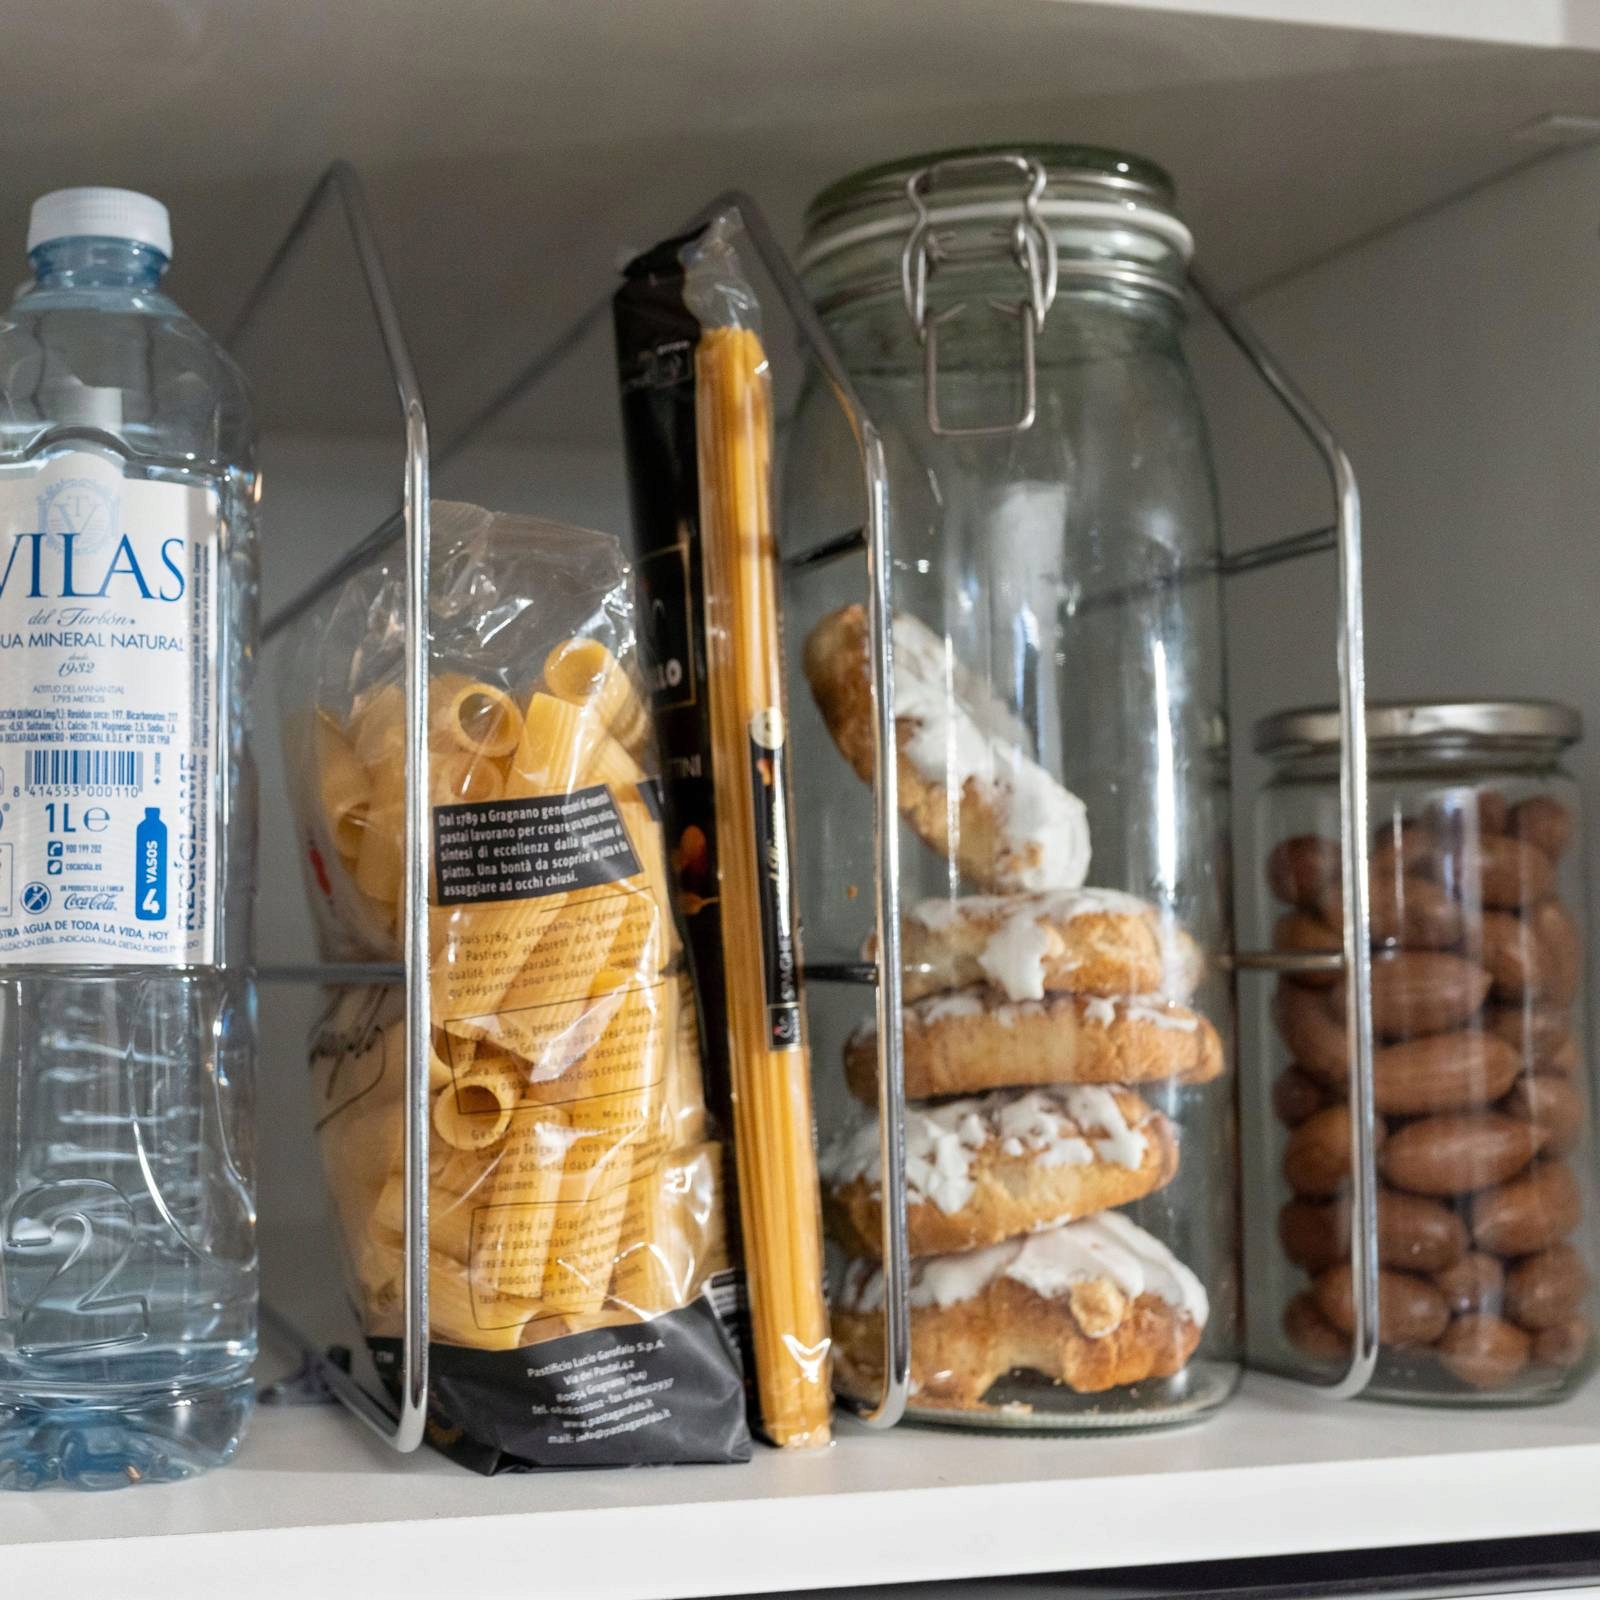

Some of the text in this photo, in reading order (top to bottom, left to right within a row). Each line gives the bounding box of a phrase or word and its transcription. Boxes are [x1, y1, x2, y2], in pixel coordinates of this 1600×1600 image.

[28, 608, 56, 625] del
[0, 632, 185, 652] UA MINERAL NATURAL
[58, 661, 96, 678] 1982
[13, 785, 139, 798] 8 414553 000110
[438, 813, 455, 827] Dal
[456, 811, 479, 827] 1789
[480, 812, 487, 823] a
[488, 807, 540, 824] Gragnano
[440, 830, 469, 845] pastai
[470, 828, 516, 842] lavorano
[518, 826, 535, 840] per
[538, 822, 571, 836] creare
[440, 847, 473, 861] sintesi
[478, 845, 488, 858] di
[493, 842, 549, 857] eccellenza
[554, 836, 579, 851] dalla
[442, 864, 475, 881] piatto.
[477, 864, 498, 876] Una
[501, 858, 532, 874] bontà
[535, 858, 549, 870] da
[552, 851, 590, 869] scoprire
[142, 840, 161, 914] 4 VASOS
[443, 869, 579, 898] assaggiare ad occhi chiusi.
[23, 921, 52, 935] AGUA
[54, 920, 68, 931] DE
[71, 920, 100, 931] TODA
[103, 923, 116, 934] LA
[148, 929, 169, 941] HOY
